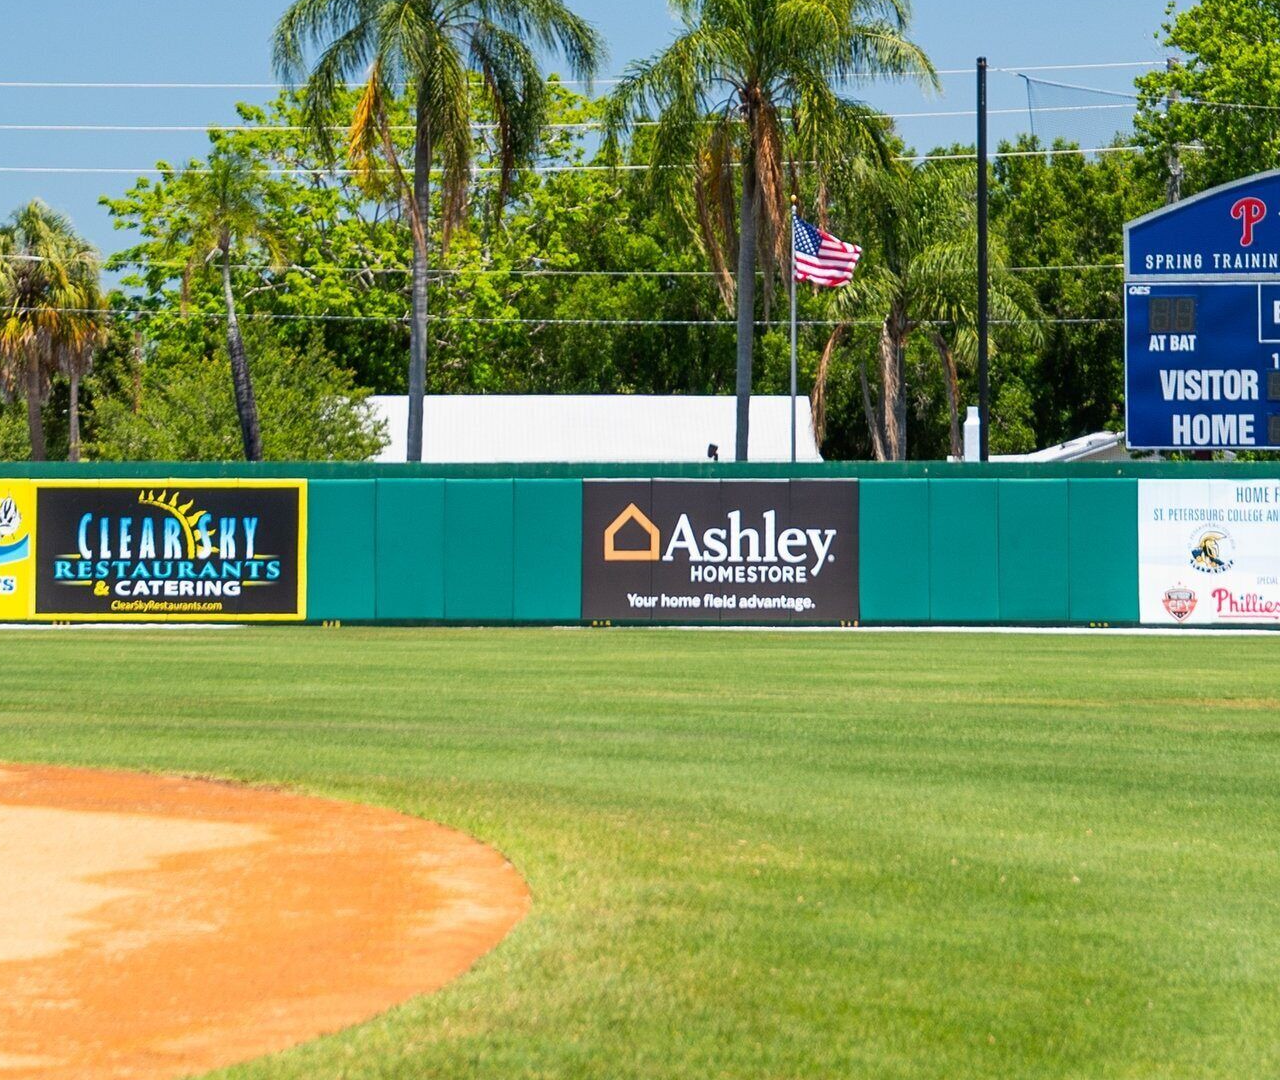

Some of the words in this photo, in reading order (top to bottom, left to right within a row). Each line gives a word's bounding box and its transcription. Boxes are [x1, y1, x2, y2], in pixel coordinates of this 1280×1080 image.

[1230, 196, 1267, 247] P
[1145, 253, 1202, 269] SPRING
[1149, 335, 1167, 352] AT
[1170, 334, 1197, 352] BAT
[1271, 352, 1280, 369] 1
[1159, 369, 1259, 401] VISITOR
[1172, 414, 1256, 446] HOME
[1236, 487, 1270, 503] HOME
[1168, 508, 1225, 522] PETERSBURG
[1227, 508, 1263, 522] COLLEGE
[78, 512, 183, 560] CLEAR
[195, 512, 259, 560] SKY
[54, 560, 281, 580] RESTAURANTS
[690, 565, 807, 584] HOMESTORE
[93, 581, 110, 597] &
[114, 580, 242, 597] CATERING
[110, 600, 223, 613] ClearSkyRestaurants.com
[627, 593, 658, 608] Your
[661, 593, 700, 608] home
[703, 593, 736, 608] field
[738, 594, 816, 612] advantage.
